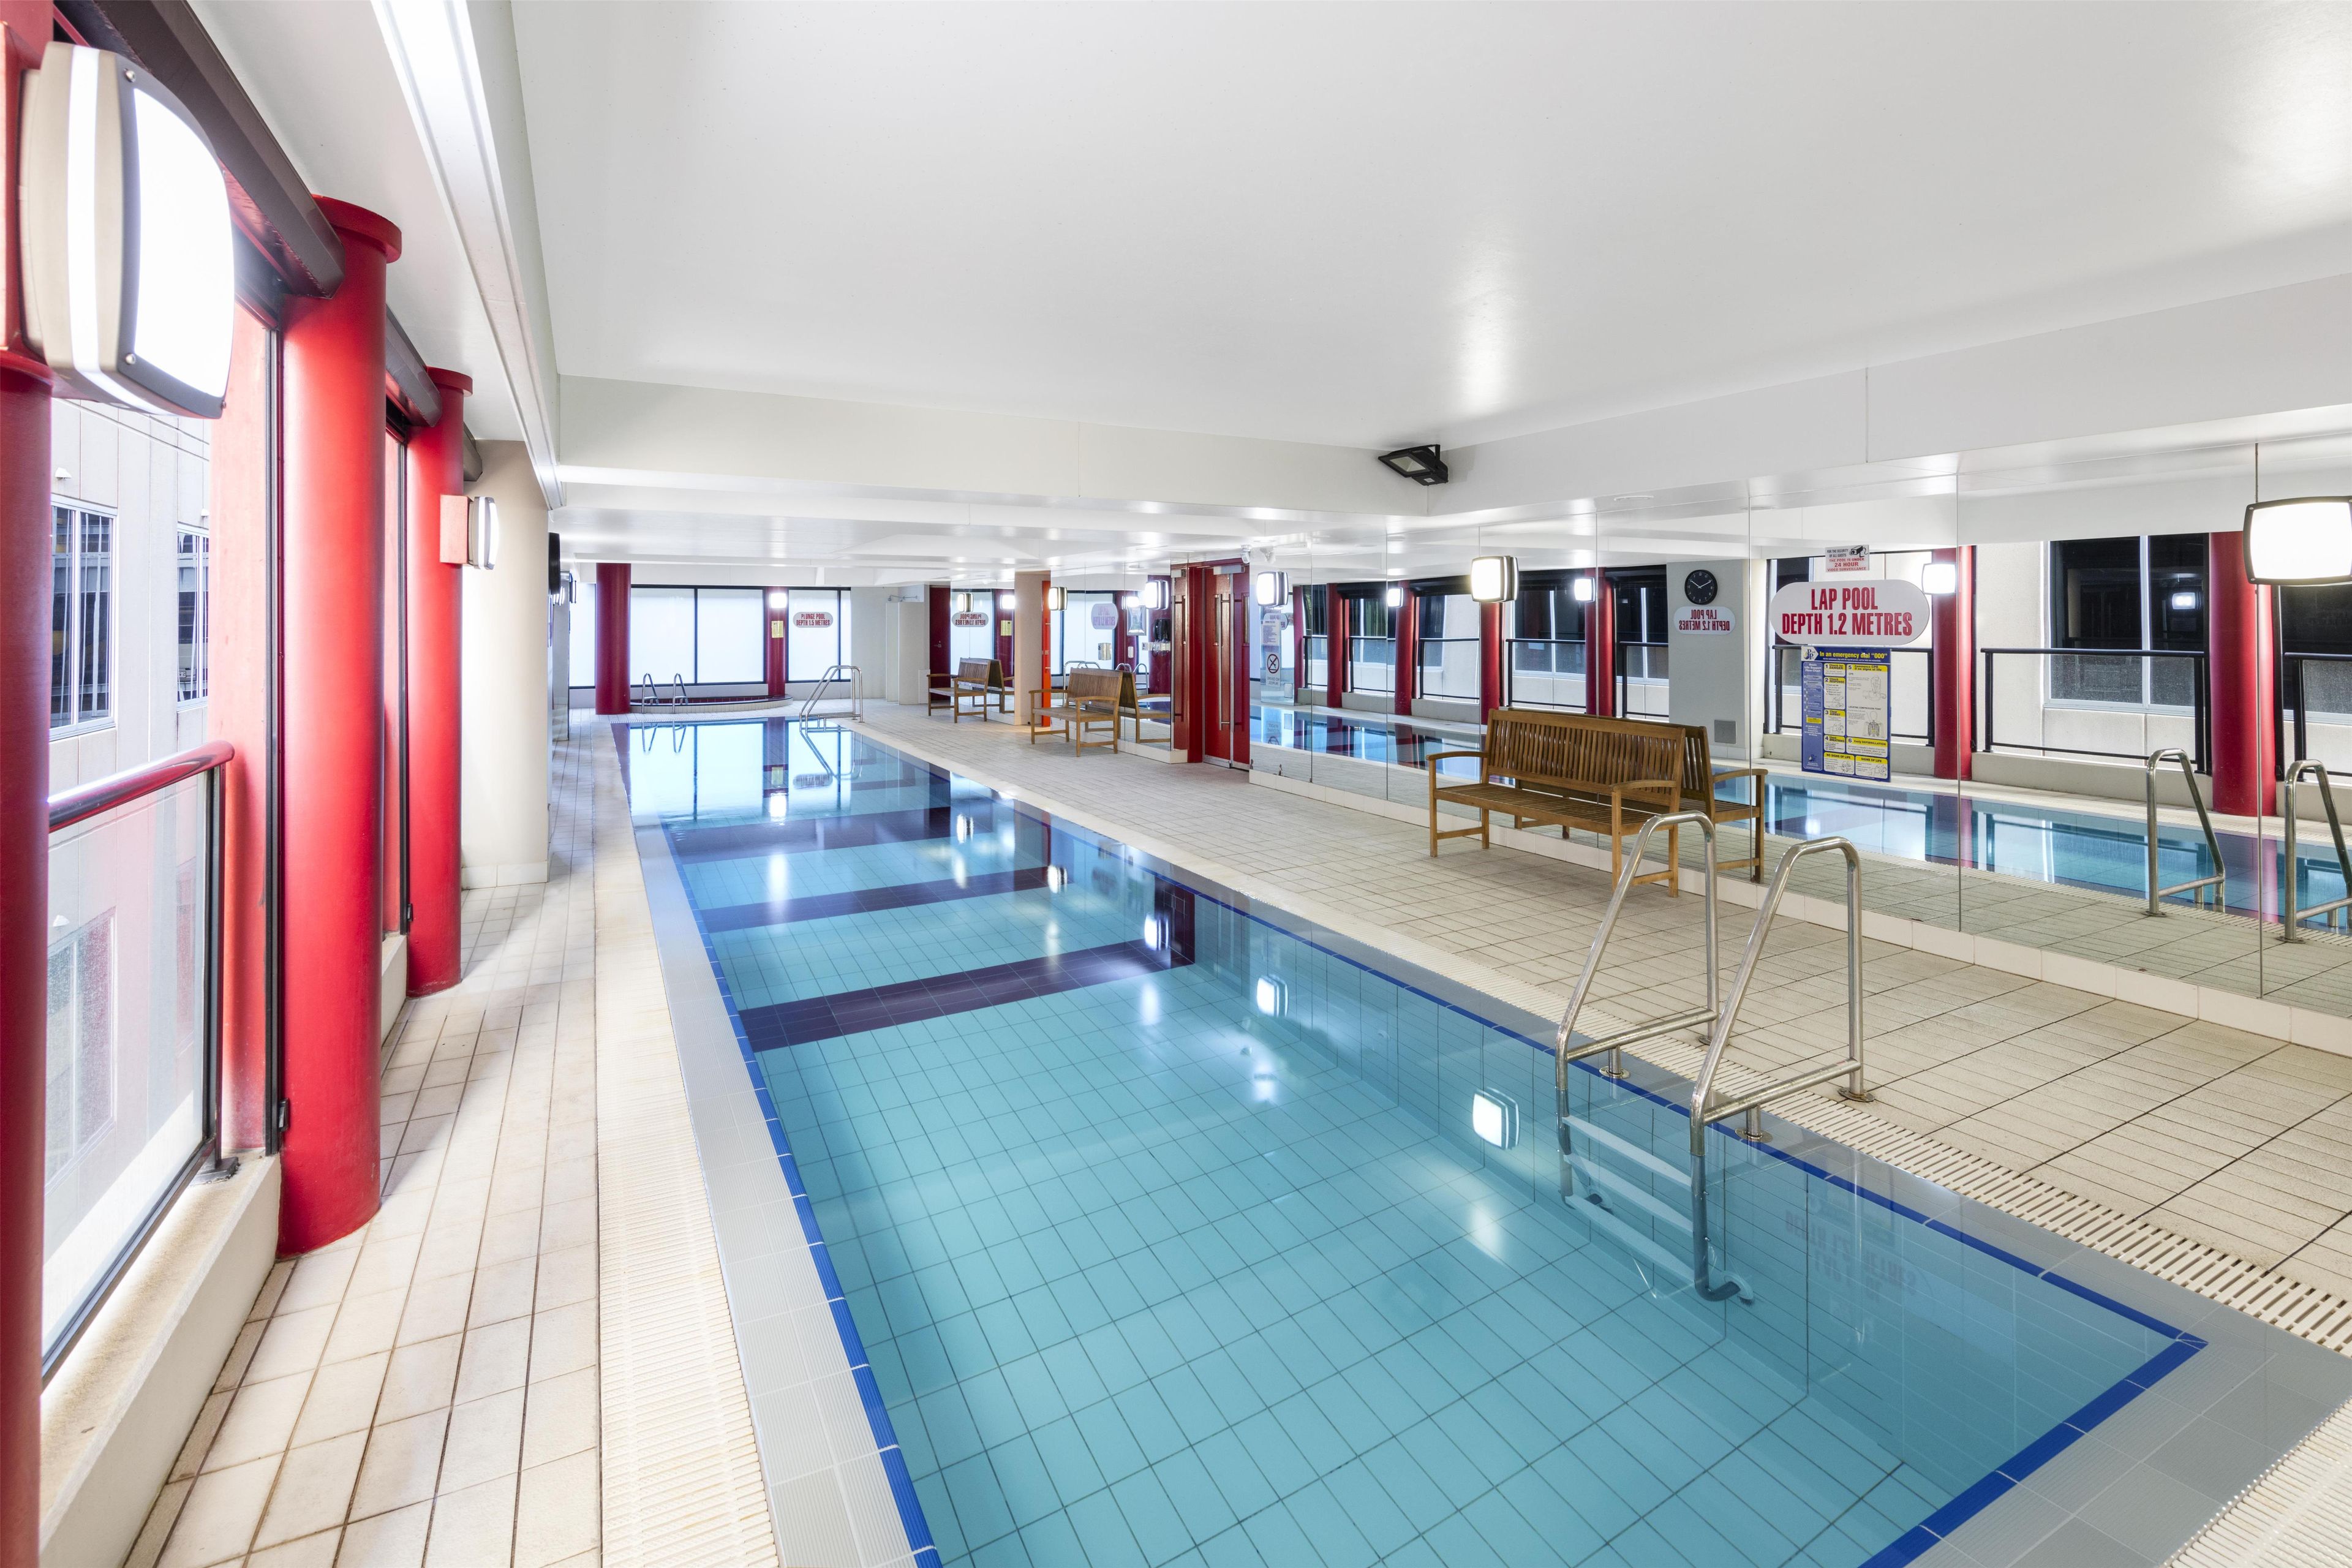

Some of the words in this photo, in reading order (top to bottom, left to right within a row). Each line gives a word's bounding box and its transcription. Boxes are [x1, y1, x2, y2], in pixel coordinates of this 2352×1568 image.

[1811, 588, 1837, 610] LAP
[1842, 587, 1878, 610] POOL
[1782, 613, 1823, 635] DEPTH
[1827, 613, 1847, 635] 1.2
[1852, 612, 1912, 636] METRES
